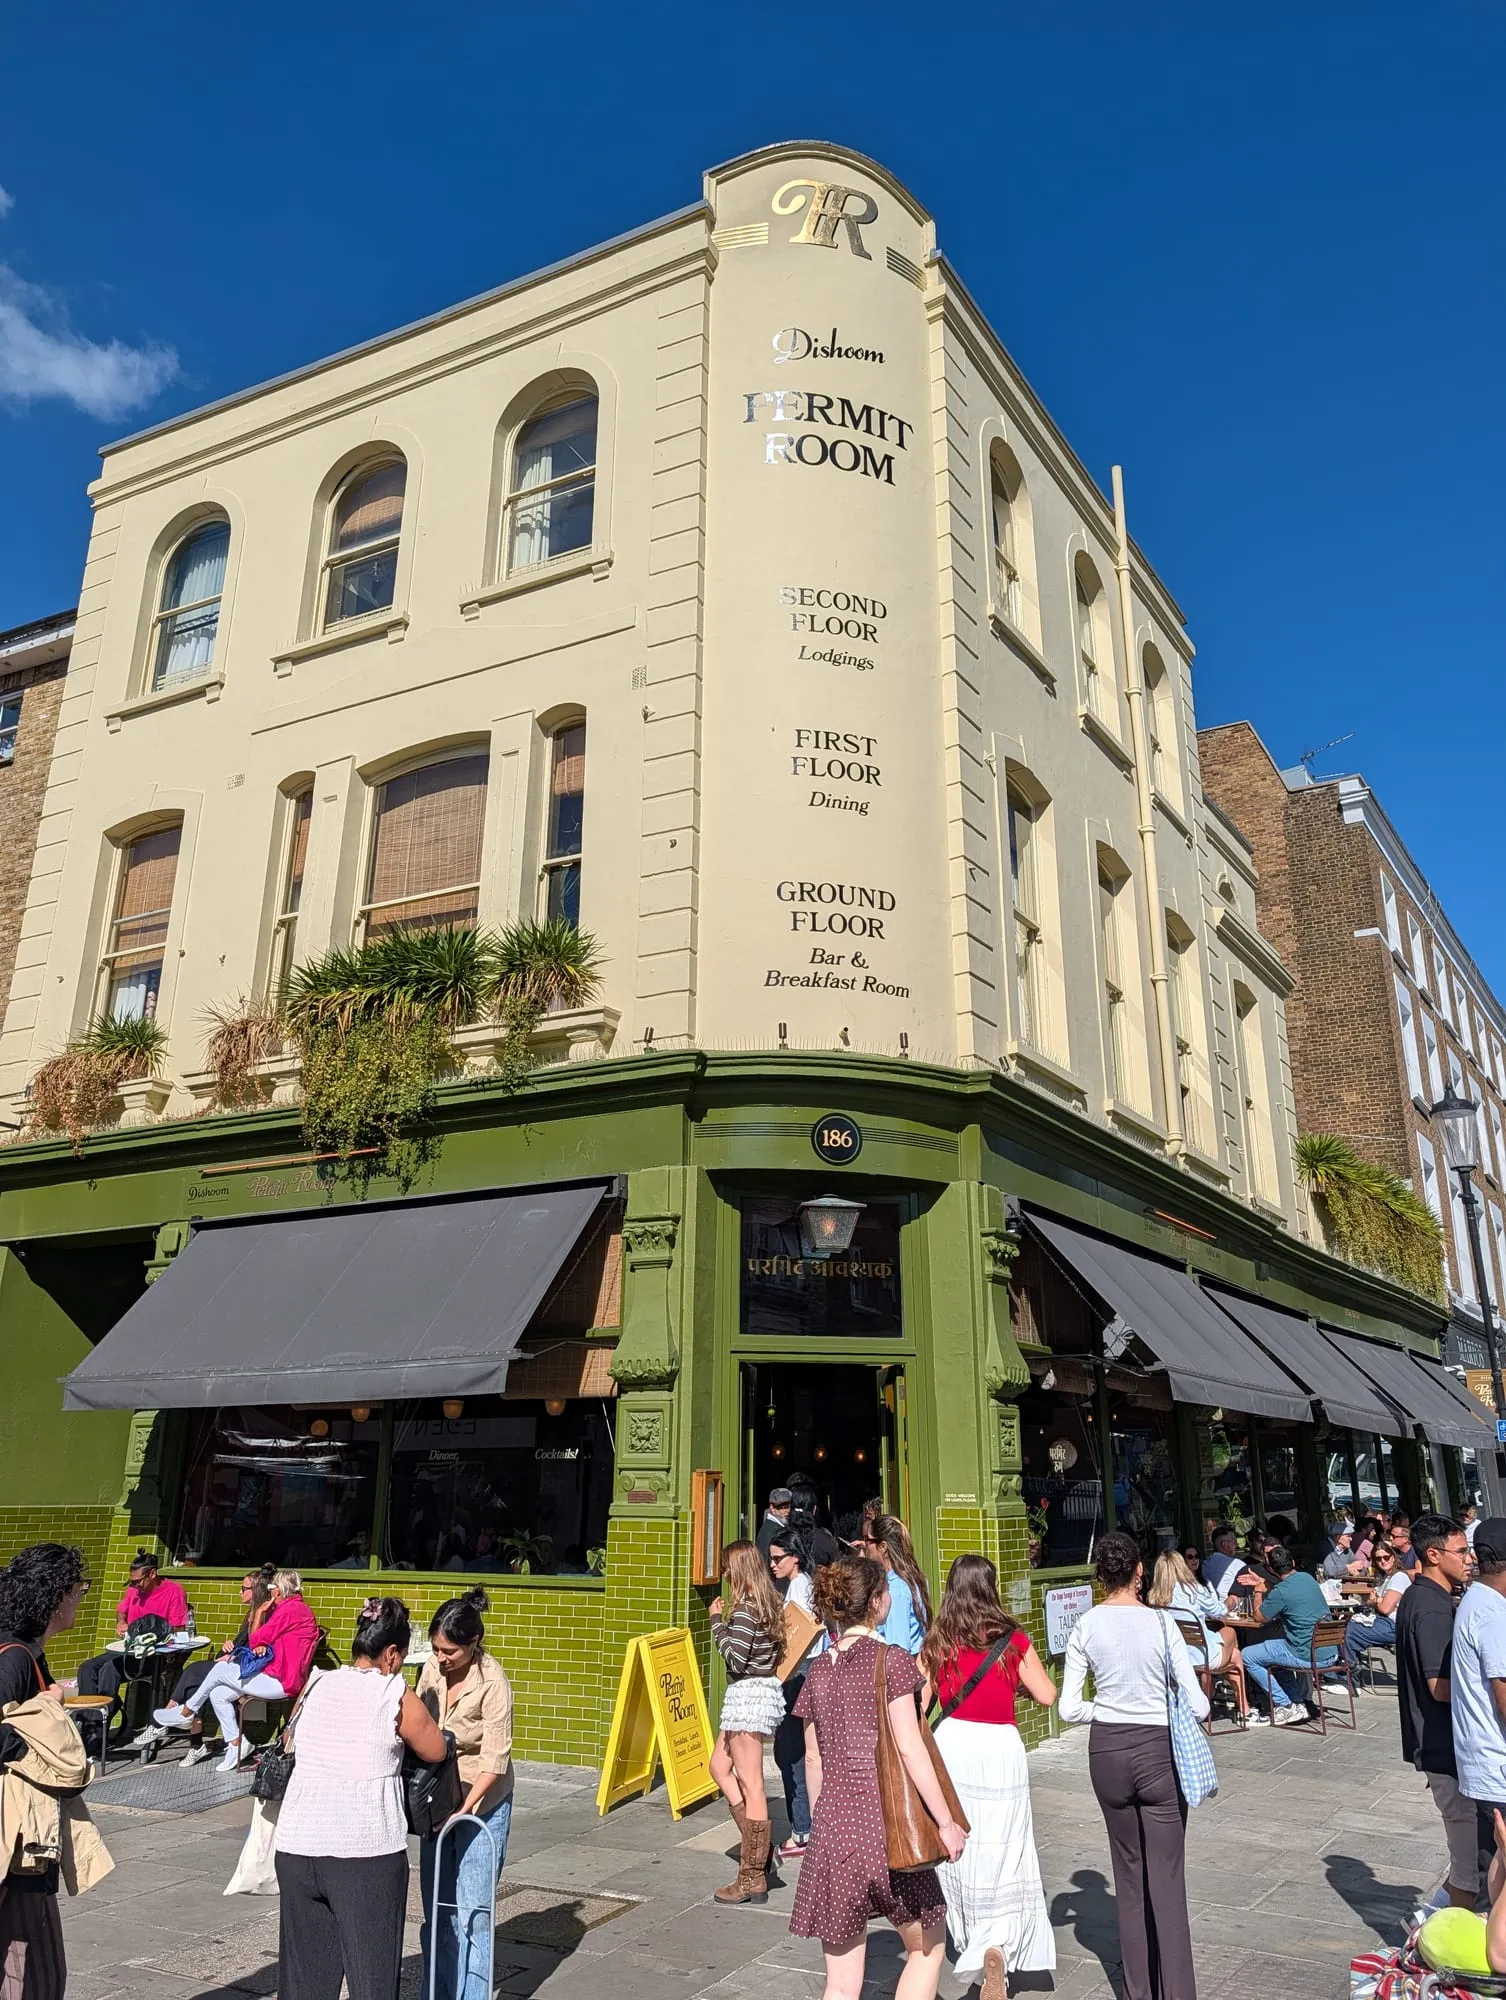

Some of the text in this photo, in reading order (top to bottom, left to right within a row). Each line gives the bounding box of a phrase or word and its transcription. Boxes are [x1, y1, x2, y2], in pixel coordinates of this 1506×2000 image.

[772, 327, 885, 365] Dishoom
[743, 390, 914, 451] PERMIT
[763, 432, 896, 486] ROOM
[779, 586, 887, 619] SECOND
[790, 613, 879, 643] FLOOR
[797, 645, 875, 671] Lodgings
[794, 728, 878, 757] FIRST
[790, 756, 882, 786] FLOOR
[808, 791, 870, 816] Dining
[776, 880, 896, 912] GROUND
[790, 911, 885, 939] FLOOR
[809, 947, 869, 969] Bar &
[763, 970, 910, 998] Breakfast Room
[821, 1129, 853, 1148] 186
[187, 1186, 230, 1201] Dishoom
[534, 1448, 579, 1460] Cocktails!
[659, 1672, 686, 1697] Permit
[669, 1697, 697, 1722] Room
